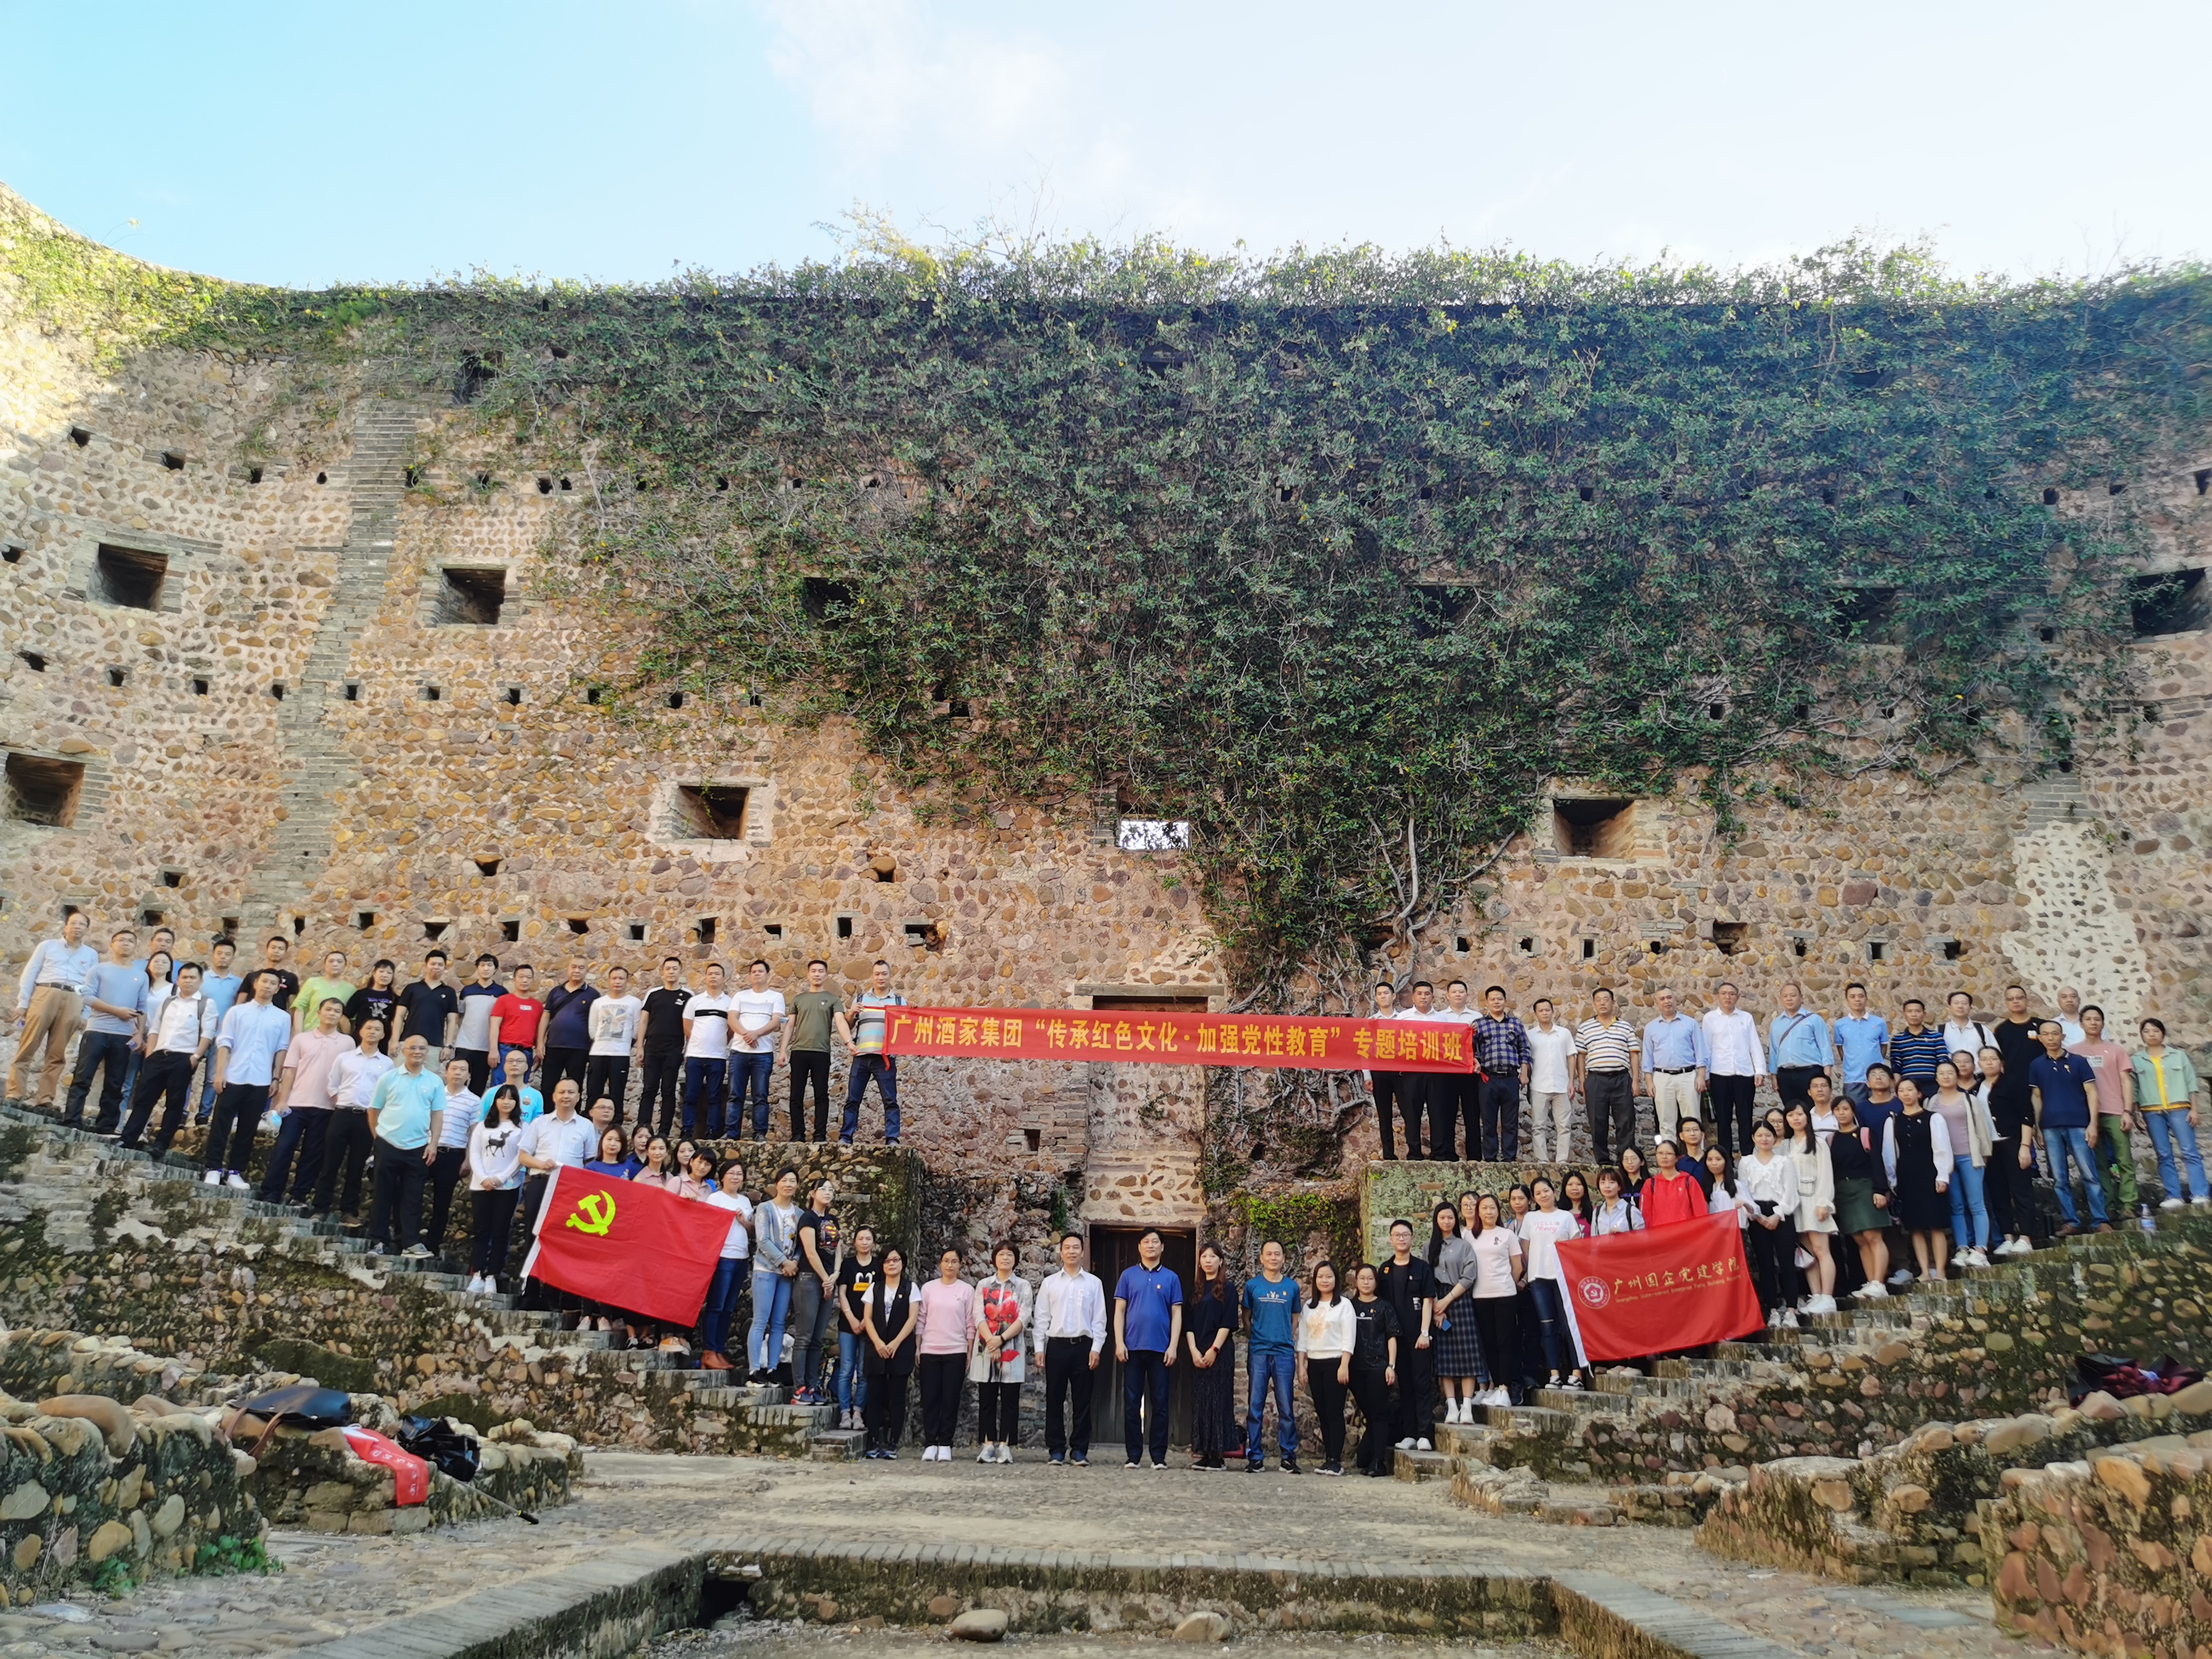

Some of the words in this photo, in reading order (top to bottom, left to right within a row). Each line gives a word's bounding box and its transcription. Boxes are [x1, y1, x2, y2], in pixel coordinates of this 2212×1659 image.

[891, 1014, 1023, 1048] 广州酒家集团
[1353, 1027, 1463, 1062] 专题培训班
[1614, 1256, 1739, 1295] 广州国企党建学院
